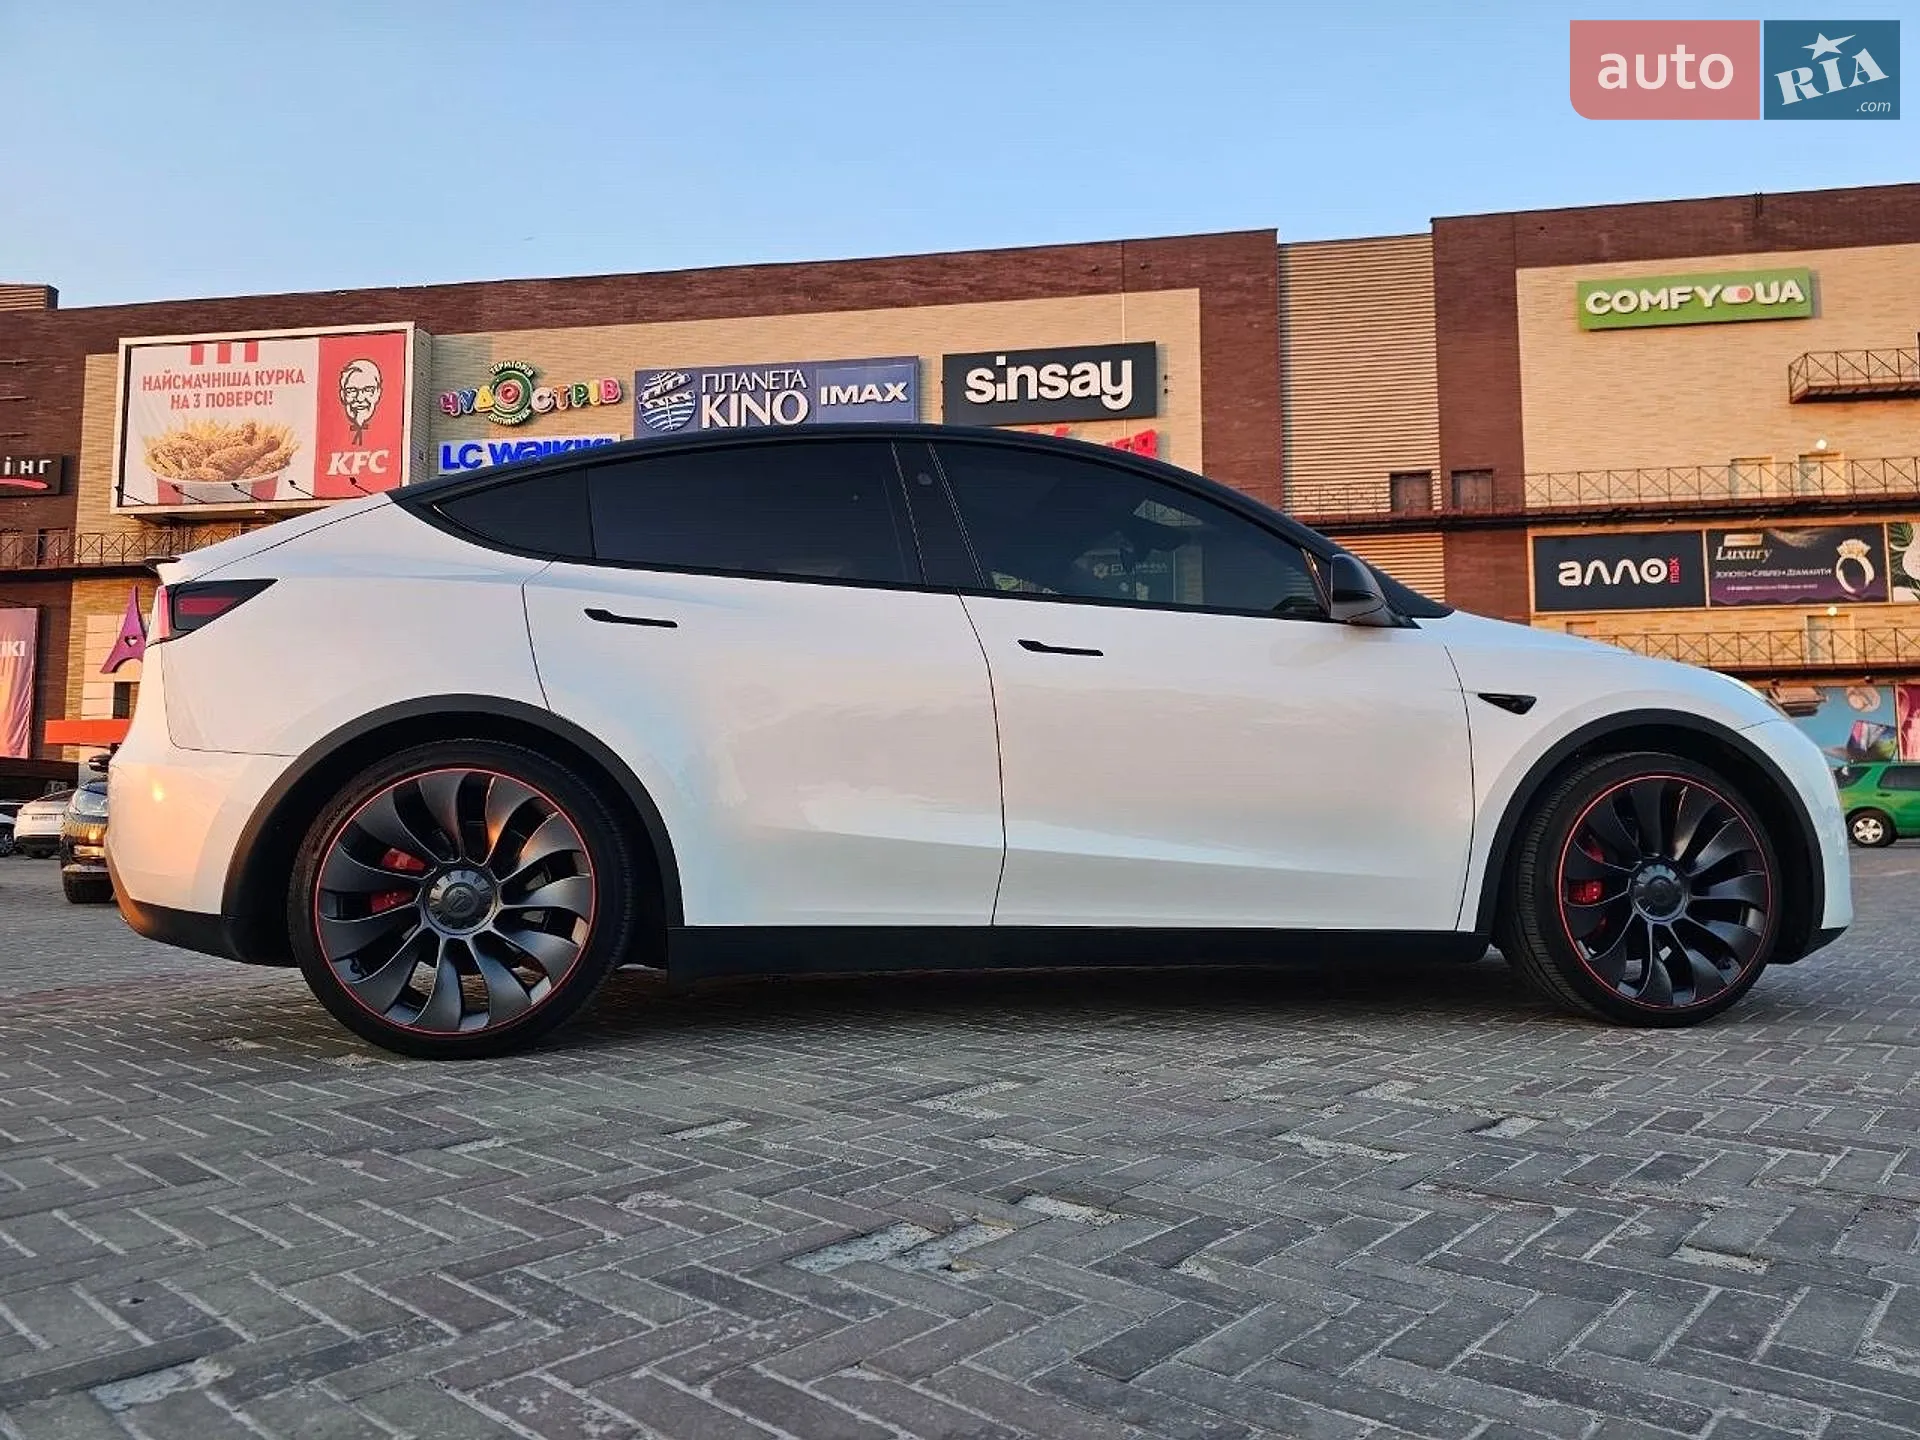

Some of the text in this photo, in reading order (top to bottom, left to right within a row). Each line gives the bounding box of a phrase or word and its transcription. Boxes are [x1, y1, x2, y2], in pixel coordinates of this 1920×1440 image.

[142, 369, 306, 391] НАЙСМАЧНІША КУРКА
[965, 355, 1133, 411] sinsay
[170, 390, 274, 410] НА 3 ПОВЕРСІ!
[820, 382, 907, 405] IMAX
[326, 450, 390, 476] KFC
[442, 444, 483, 471] LC
[1716, 546, 1772, 563] Luxury
